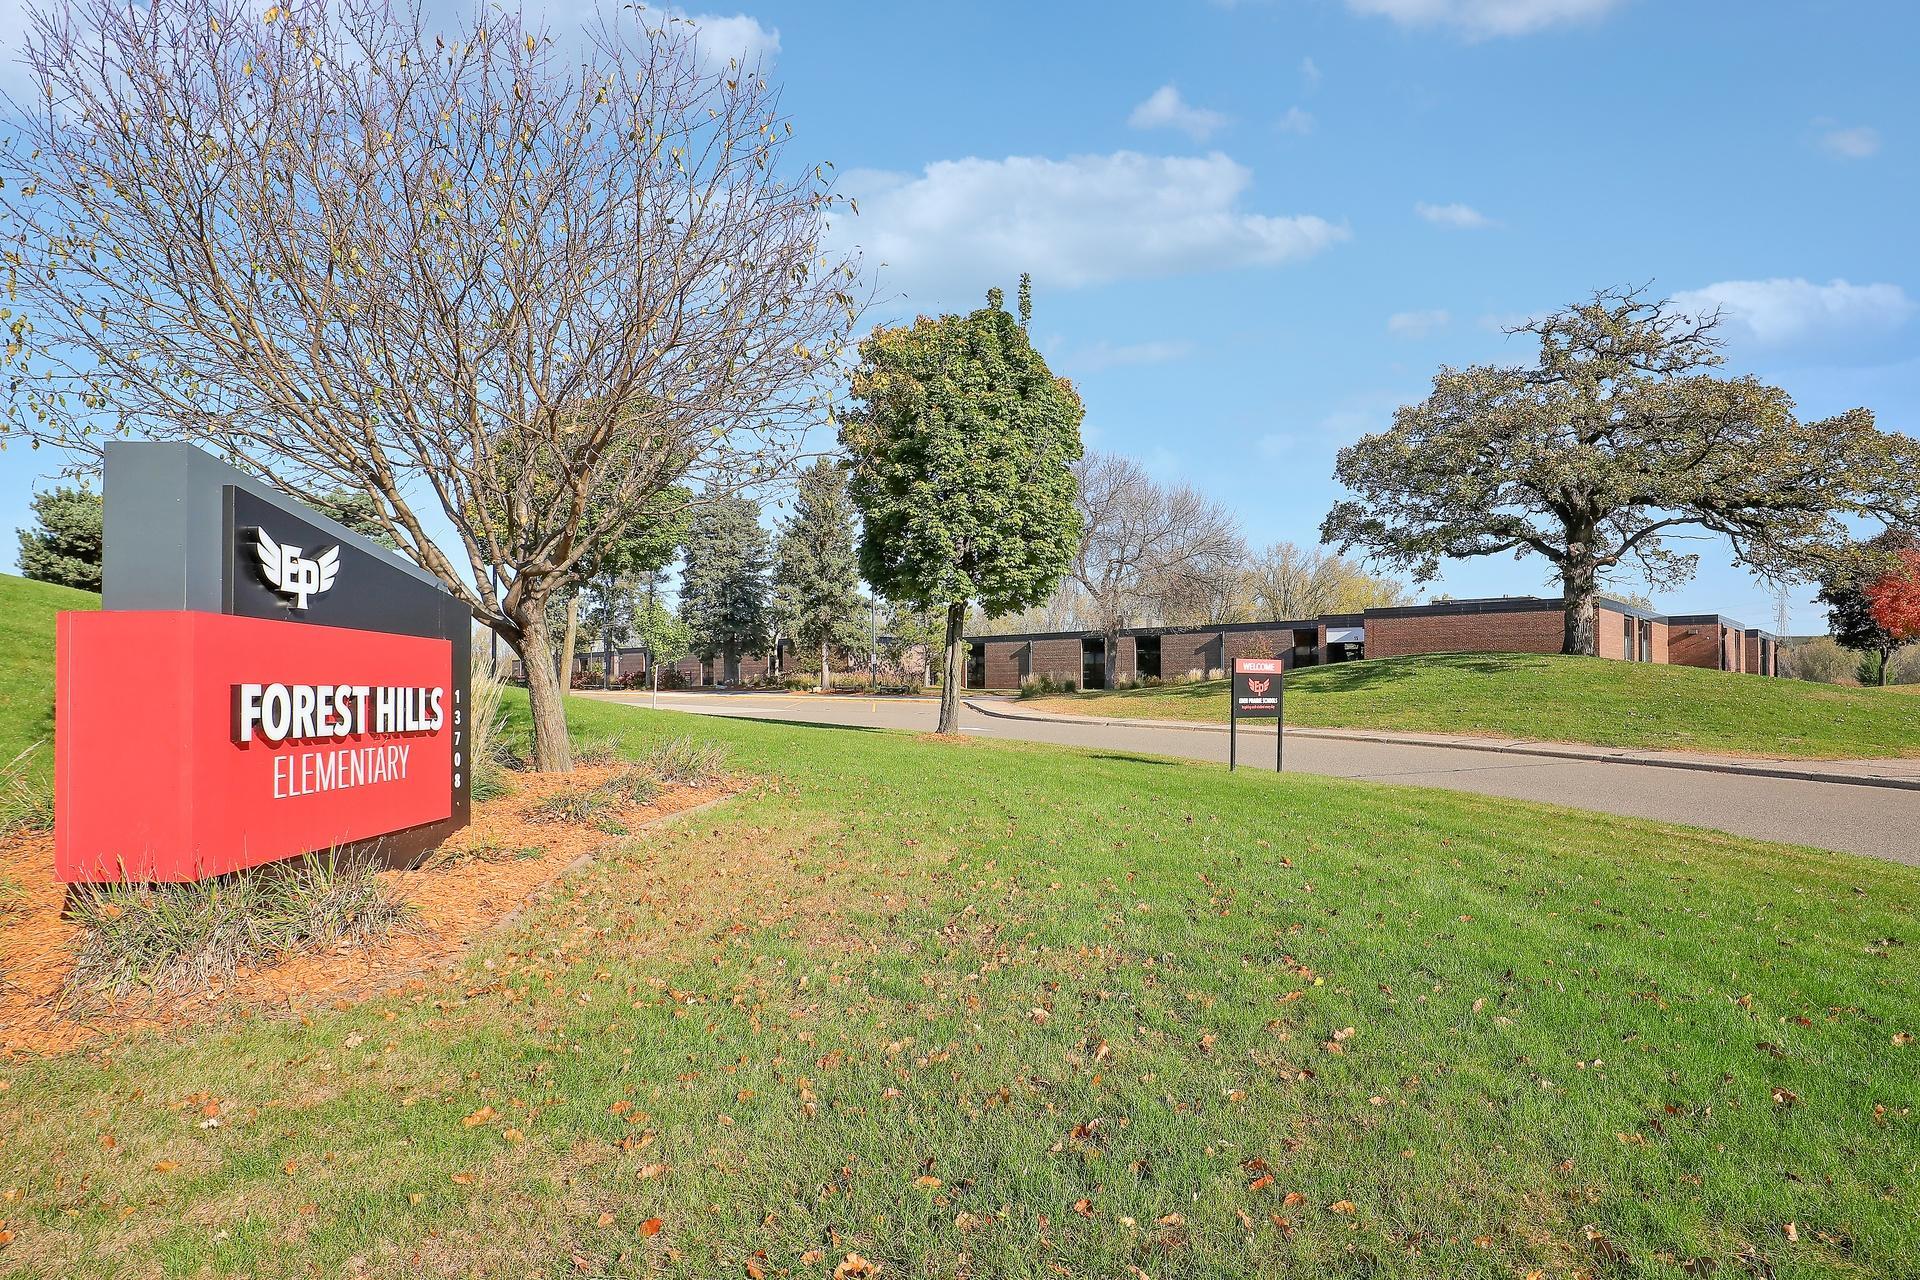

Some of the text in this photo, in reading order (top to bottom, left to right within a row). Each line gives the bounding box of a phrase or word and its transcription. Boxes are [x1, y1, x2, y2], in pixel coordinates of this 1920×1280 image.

[1243, 662, 1275, 671] WELCOME
[240, 683, 445, 742] FOREST HILLS
[453, 689, 461, 789] 13708
[274, 745, 410, 799] ELEMENTARY
